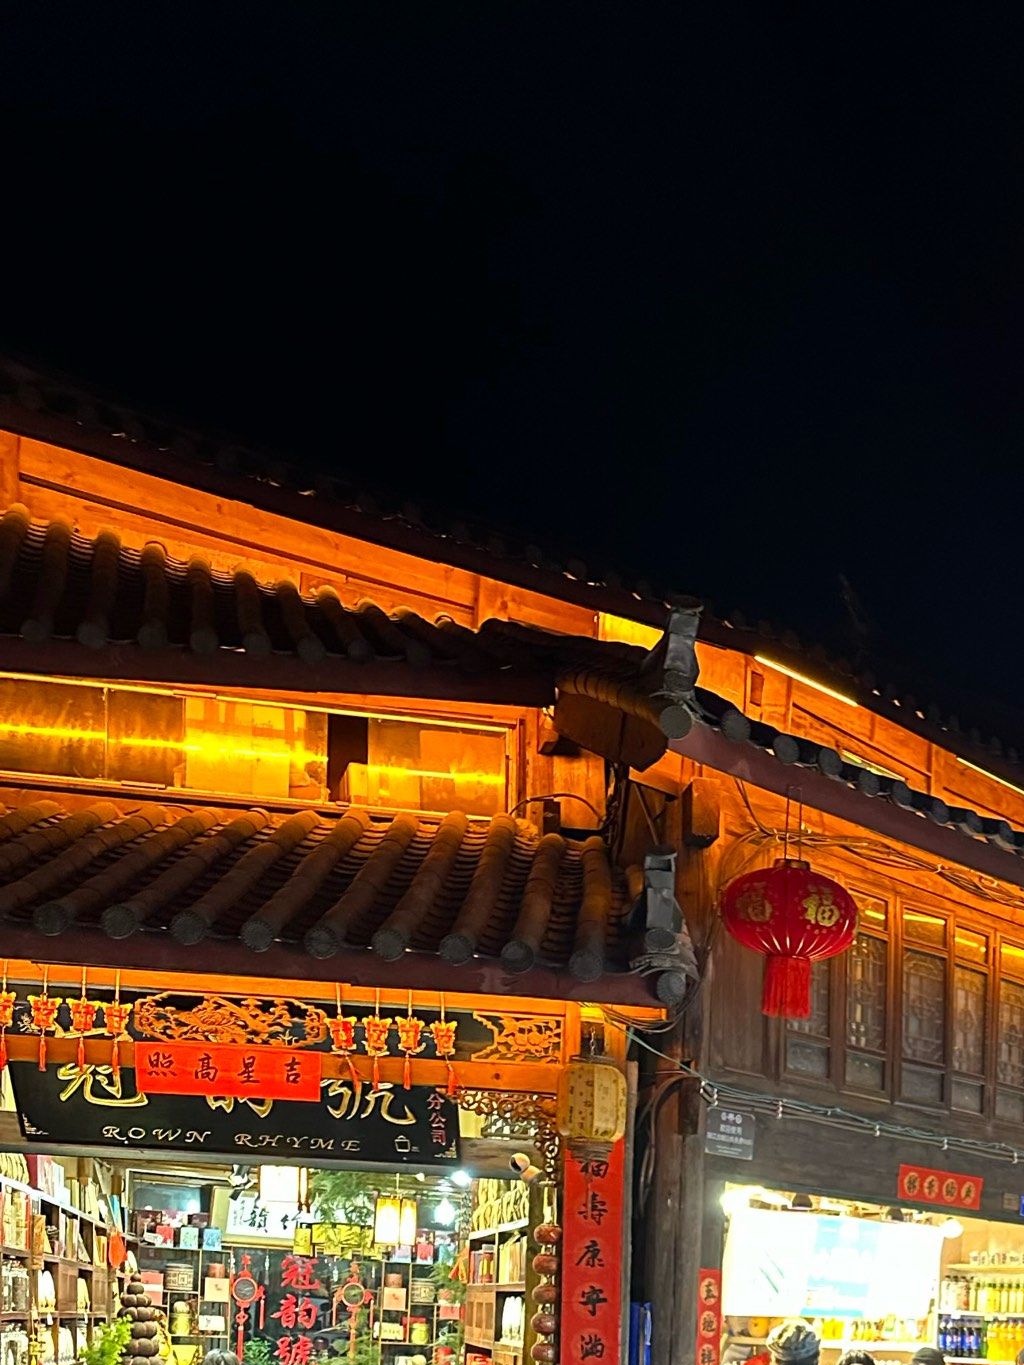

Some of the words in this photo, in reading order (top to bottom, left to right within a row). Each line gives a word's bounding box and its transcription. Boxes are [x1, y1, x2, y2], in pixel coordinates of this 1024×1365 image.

[802, 883, 842, 927] 福
[234, 1132, 361, 1151] RHYME
[426, 1093, 448, 1146] 分公司
